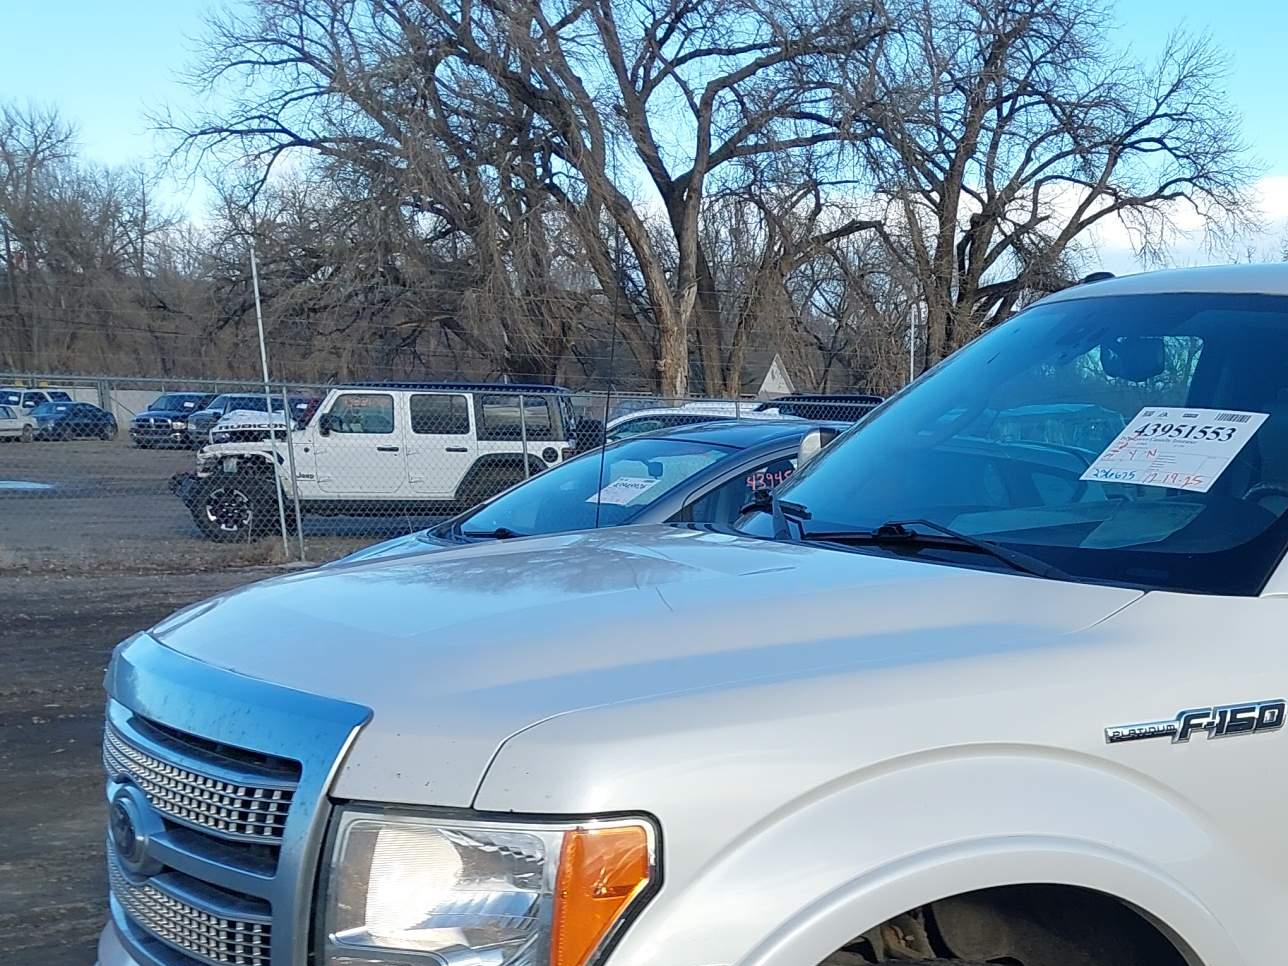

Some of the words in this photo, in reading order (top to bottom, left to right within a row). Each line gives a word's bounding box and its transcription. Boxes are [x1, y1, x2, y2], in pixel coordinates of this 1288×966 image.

[1134, 422, 1237, 442] 43951553
[1111, 724, 1176, 741] PLATINUM
[1171, 698, 1288, 744] F-150
